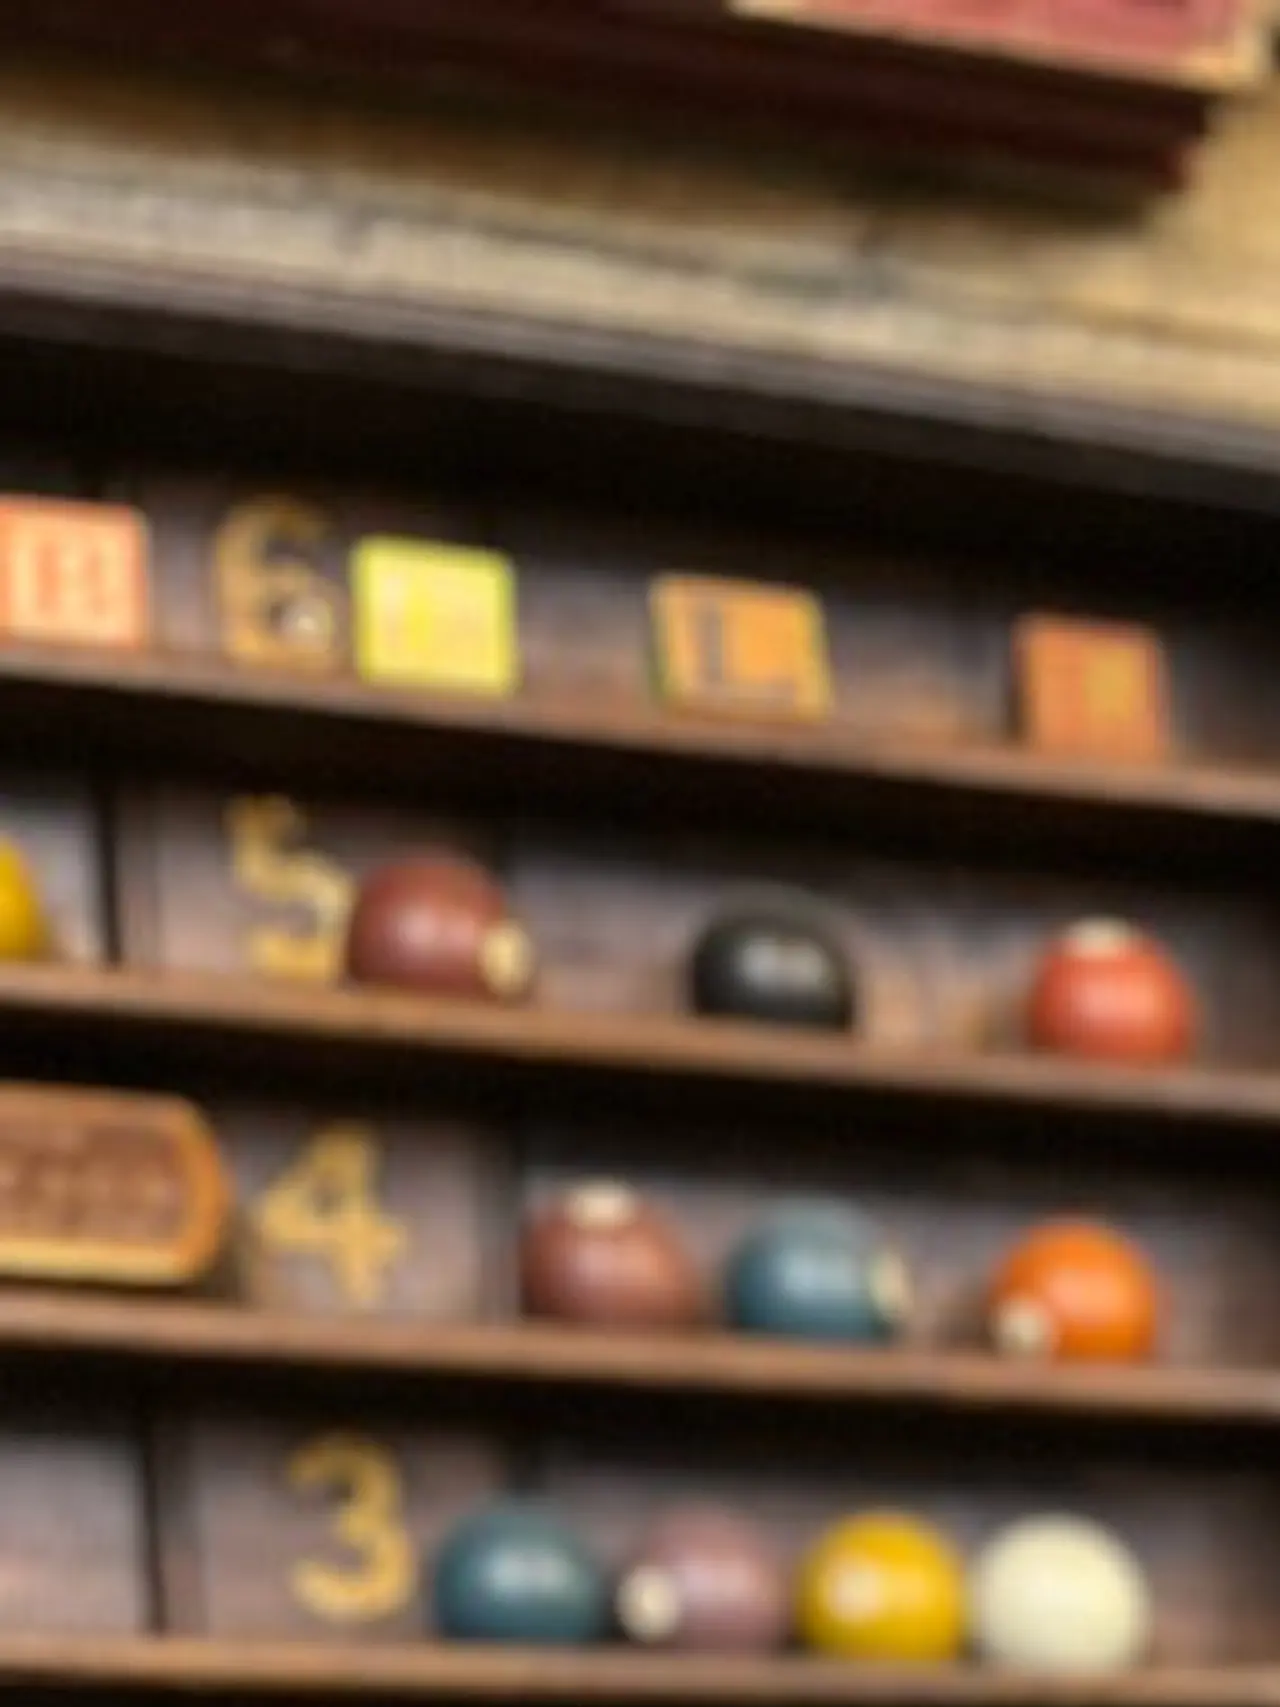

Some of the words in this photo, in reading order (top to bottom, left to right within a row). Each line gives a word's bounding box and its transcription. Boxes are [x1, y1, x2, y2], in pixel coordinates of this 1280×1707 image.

[217, 502, 336, 665] 6
[224, 795, 352, 980] 5
[262, 1126, 402, 1308] 4
[290, 1433, 412, 1620] 3
